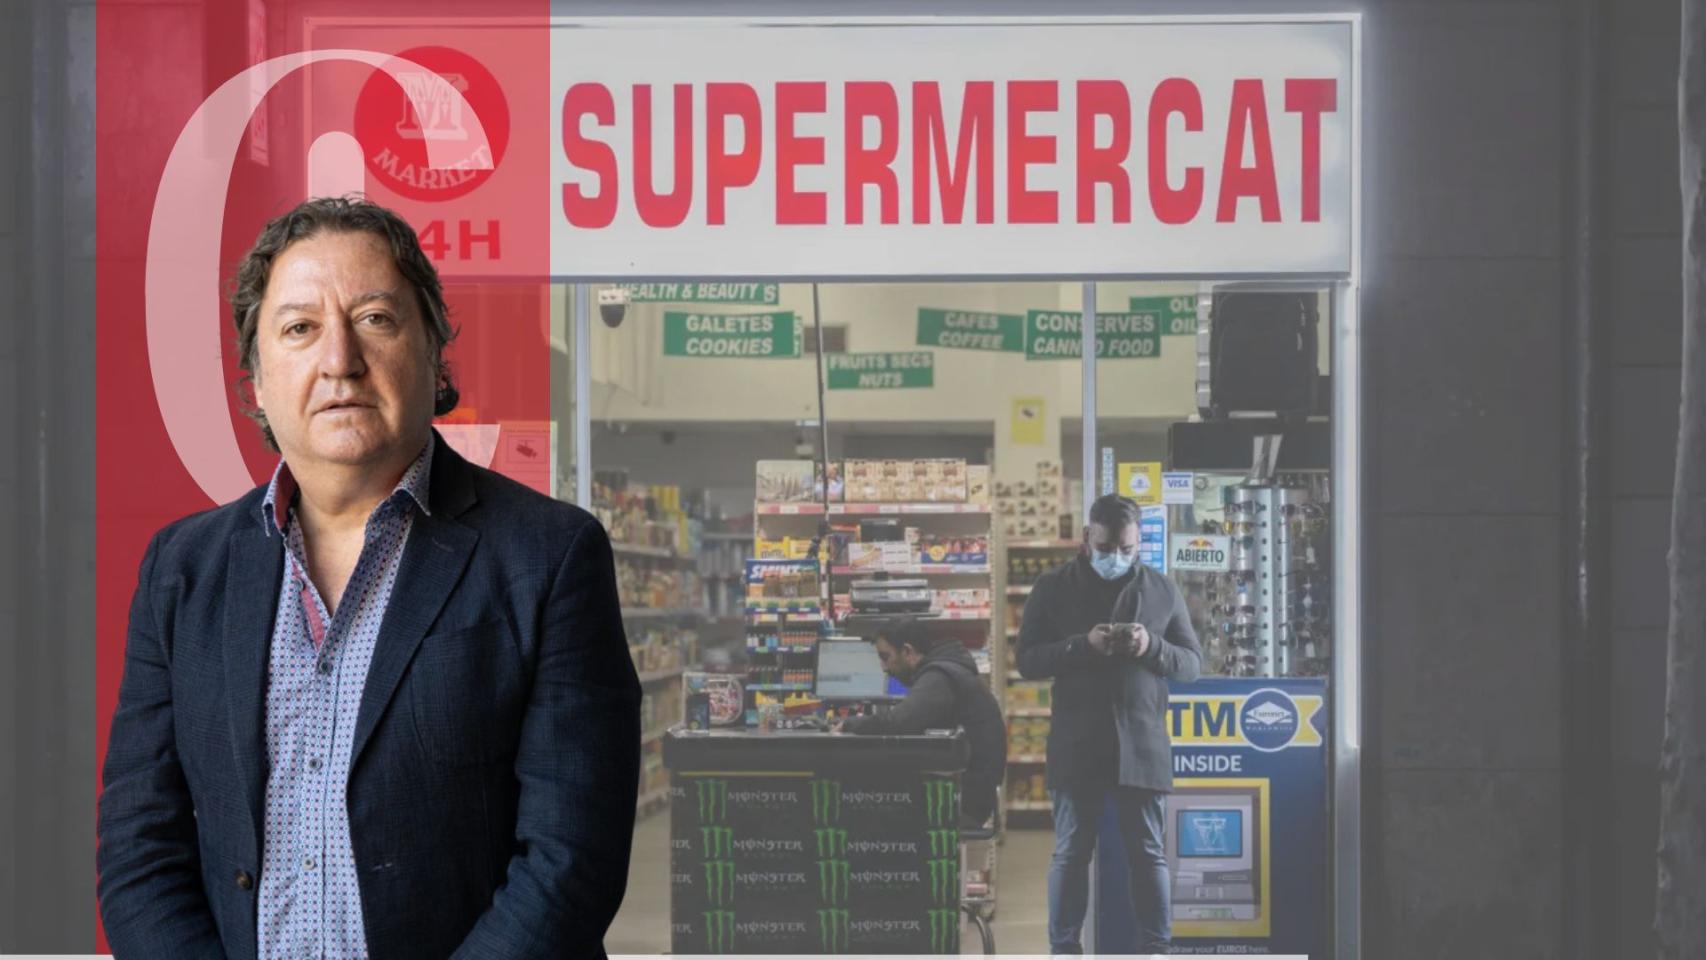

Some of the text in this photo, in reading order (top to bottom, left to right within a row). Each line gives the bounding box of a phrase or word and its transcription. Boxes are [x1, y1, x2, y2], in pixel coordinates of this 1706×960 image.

[561, 77, 1338, 229] SUPERMERCAT
[373, 145, 491, 190] MARKET
[418, 219, 500, 261] 4H
[697, 283, 758, 299] BEAUTY
[685, 315, 774, 333] GALETES
[944, 311, 999, 330] CAFES
[1035, 313, 1155, 333] CONERVES
[685, 338, 774, 355] COOKIES
[938, 331, 1004, 350] COFFEE
[1033, 337, 1154, 356] CANND FOOD
[829, 352, 932, 370] FRUITS SECS
[858, 372, 904, 387] NUTS
[1167, 479, 1190, 488] VISA
[1176, 548, 1225, 563] ABIERTO
[1168, 702, 1236, 737] TM
[1174, 755, 1242, 772] INSIDE
[728, 790, 798, 803] MONSTER
[842, 790, 911, 803] MONSTER
[733, 838, 803, 852] MONSTER
[847, 841, 917, 853] MONSTER
[735, 872, 806, 884] MONSTER
[850, 870, 920, 883] MONSTER
[735, 921, 806, 934] MONSTER
[850, 919, 920, 932] MONSTER
